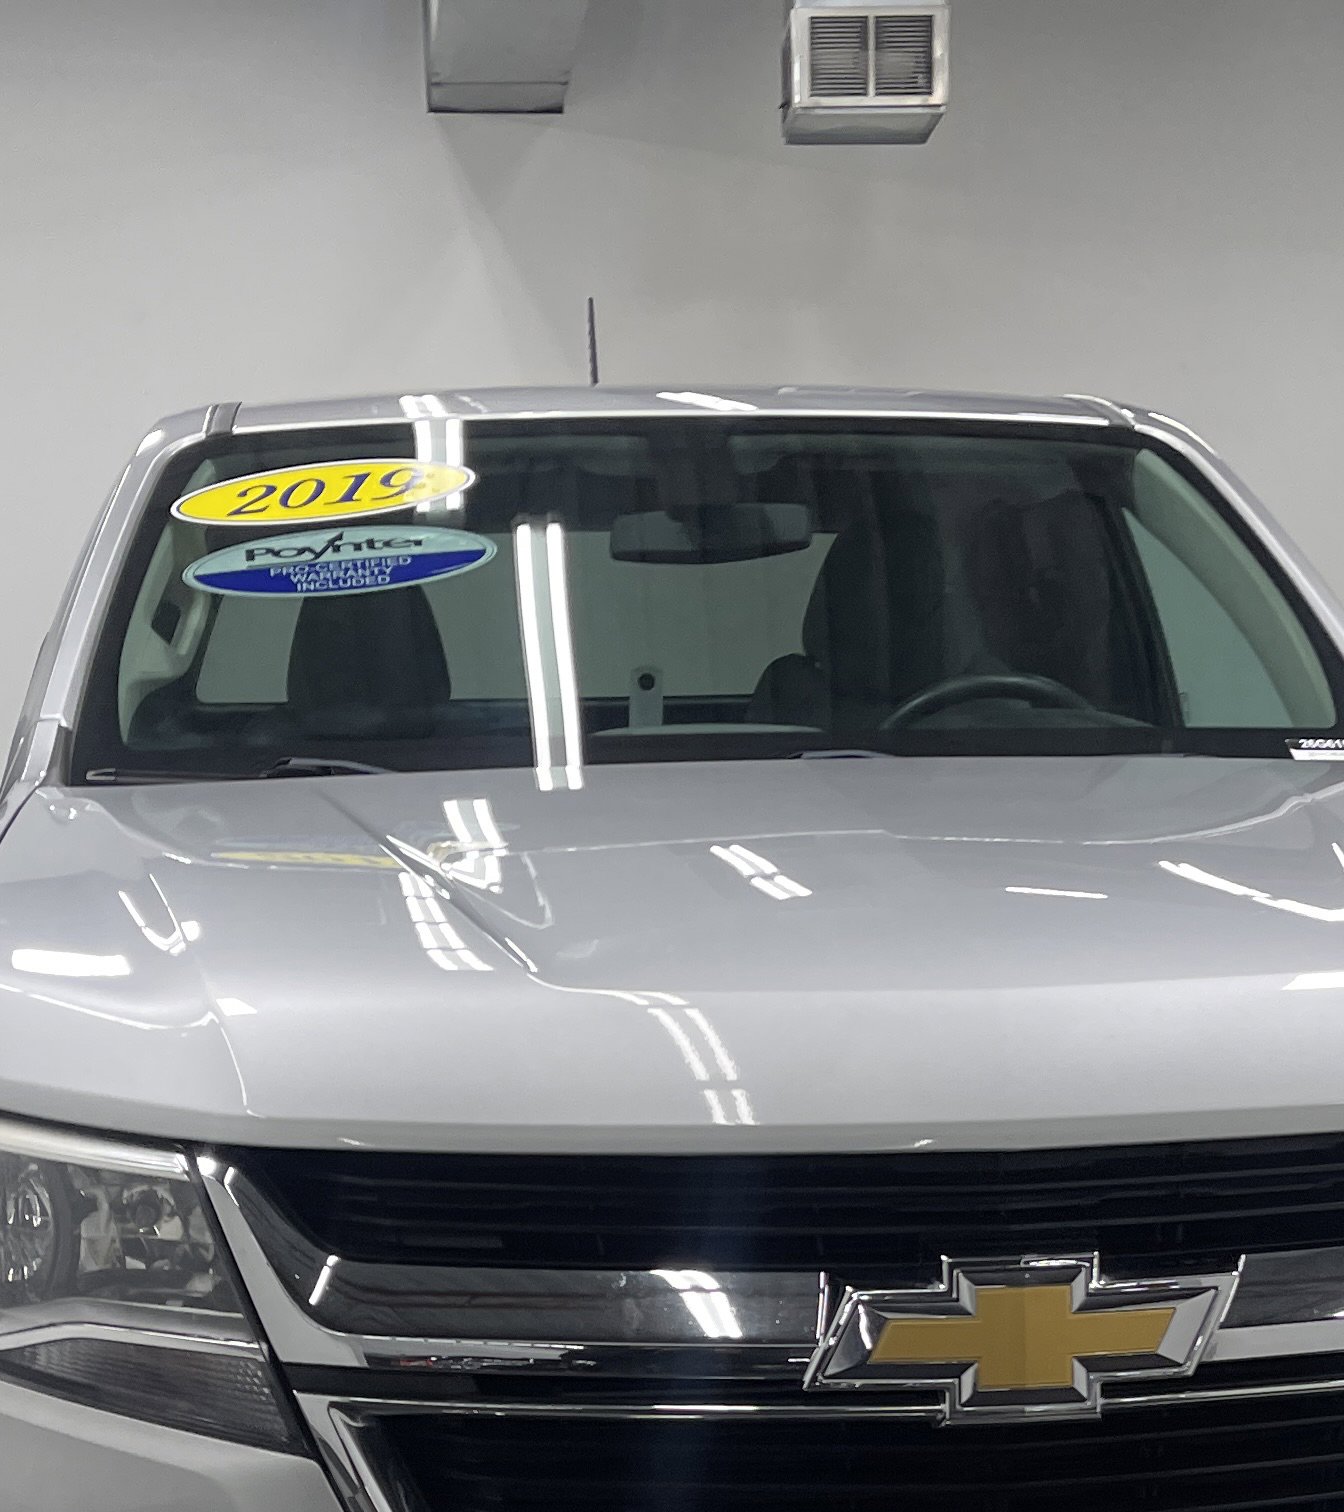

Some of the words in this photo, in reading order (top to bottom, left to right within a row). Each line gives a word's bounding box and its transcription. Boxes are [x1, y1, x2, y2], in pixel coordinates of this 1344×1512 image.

[227, 467, 424, 516] 2019
[245, 531, 423, 561] Poynter
[290, 566, 393, 583] WARRANTY
[296, 576, 390, 592] INCLUDED
